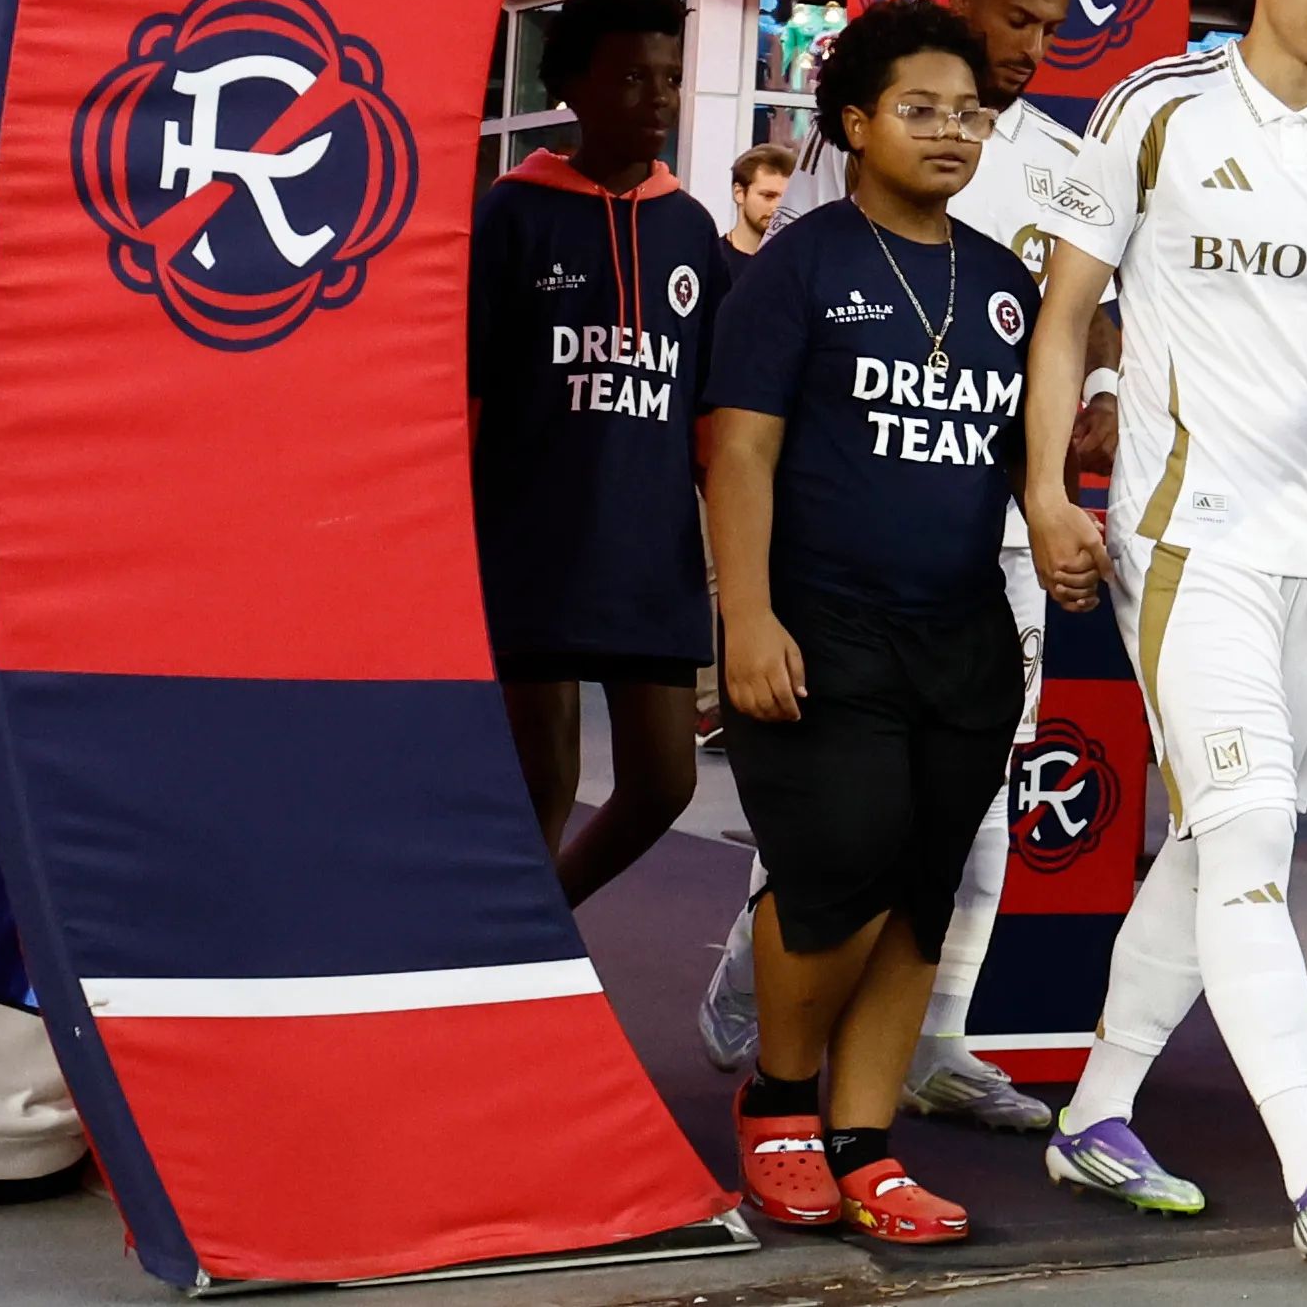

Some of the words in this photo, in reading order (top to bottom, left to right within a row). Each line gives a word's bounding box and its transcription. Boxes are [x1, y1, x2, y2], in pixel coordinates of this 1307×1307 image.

[1053, 180, 1101, 219] Ford
[1190, 235, 1307, 279] BMO
[825, 304, 893, 319] ARBELLA
[835, 314, 886, 323] INSURANCE
[552, 325, 679, 379] DREAM
[567, 373, 671, 422] TEAM
[852, 357, 1023, 417] DREAM
[868, 410, 999, 465] TEAM
